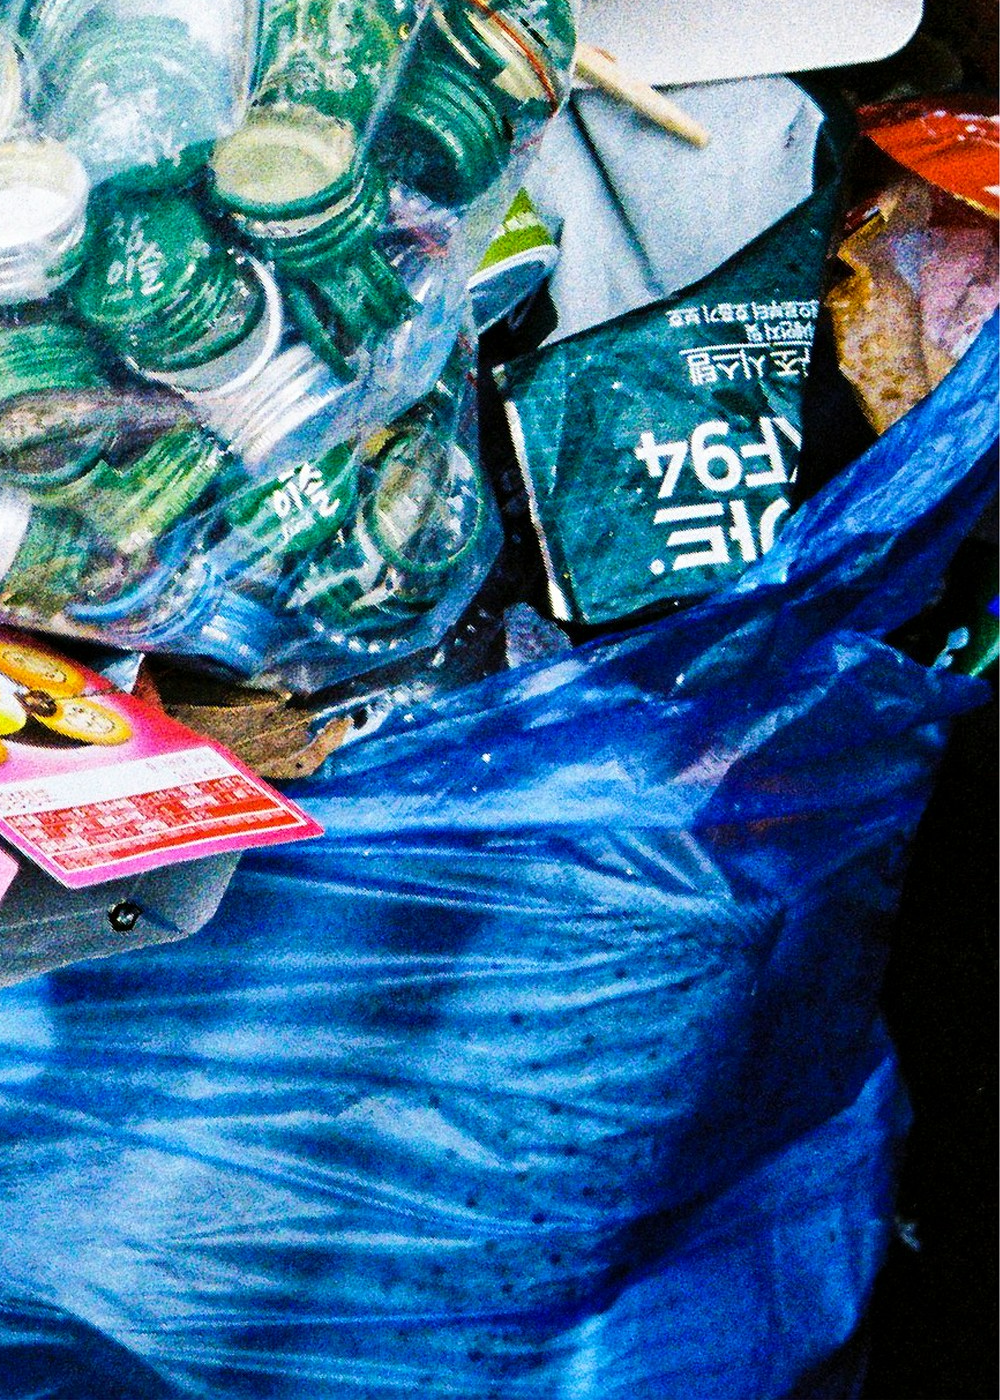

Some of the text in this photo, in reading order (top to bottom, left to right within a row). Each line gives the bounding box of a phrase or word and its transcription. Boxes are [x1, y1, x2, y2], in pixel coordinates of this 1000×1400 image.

[701, 303, 749, 323] 호흡기
[686, 349, 767, 386] 시스템
[272, 463, 340, 518] 이슬
